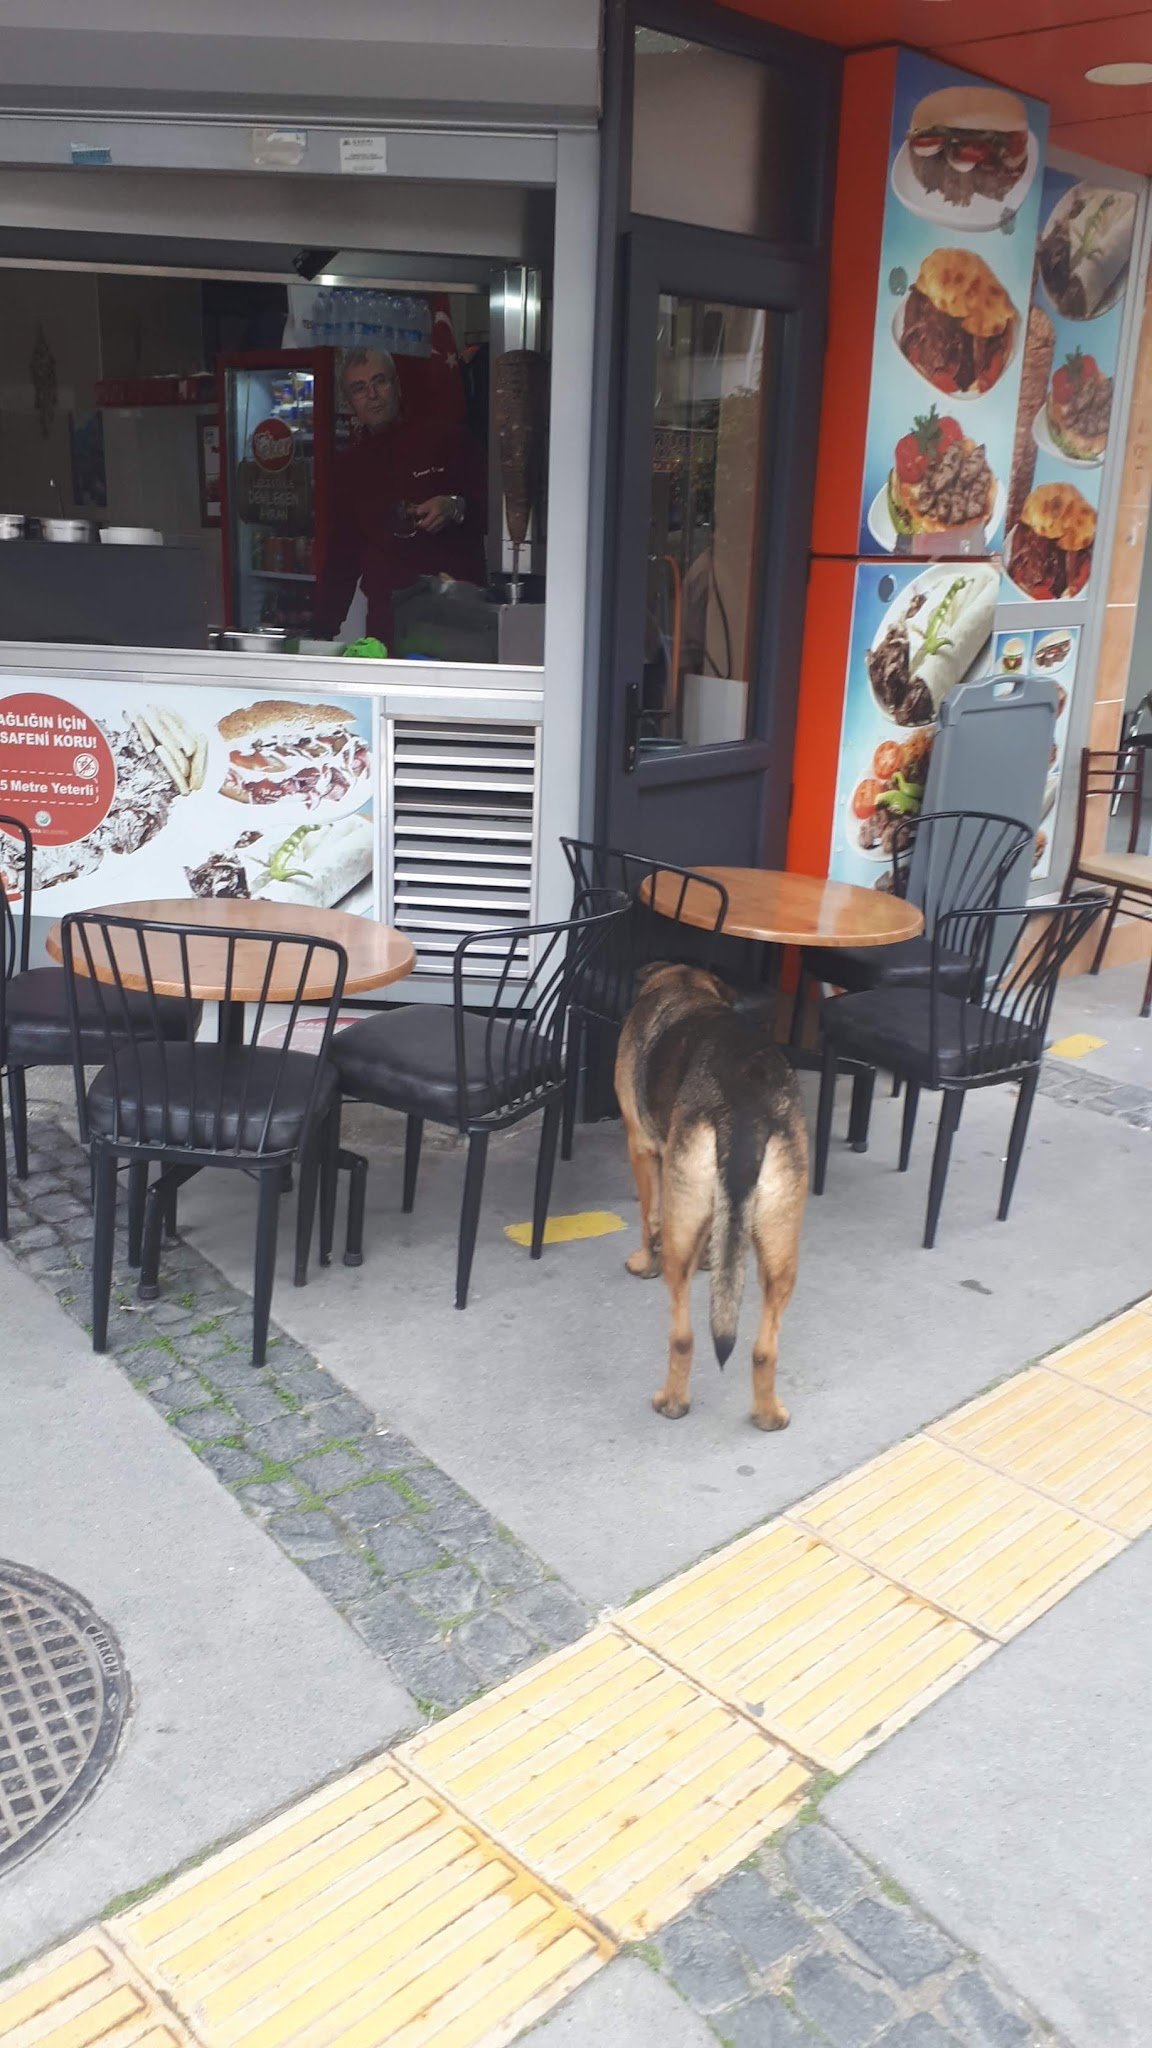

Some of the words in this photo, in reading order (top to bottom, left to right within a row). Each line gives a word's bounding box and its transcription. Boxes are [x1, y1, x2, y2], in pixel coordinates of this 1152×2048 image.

[58, 714, 87, 732] İÇİN
[53, 734, 97, 749] KORU!
[10, 780, 48, 793] Metre
[51, 782, 94, 796] Yeterli
